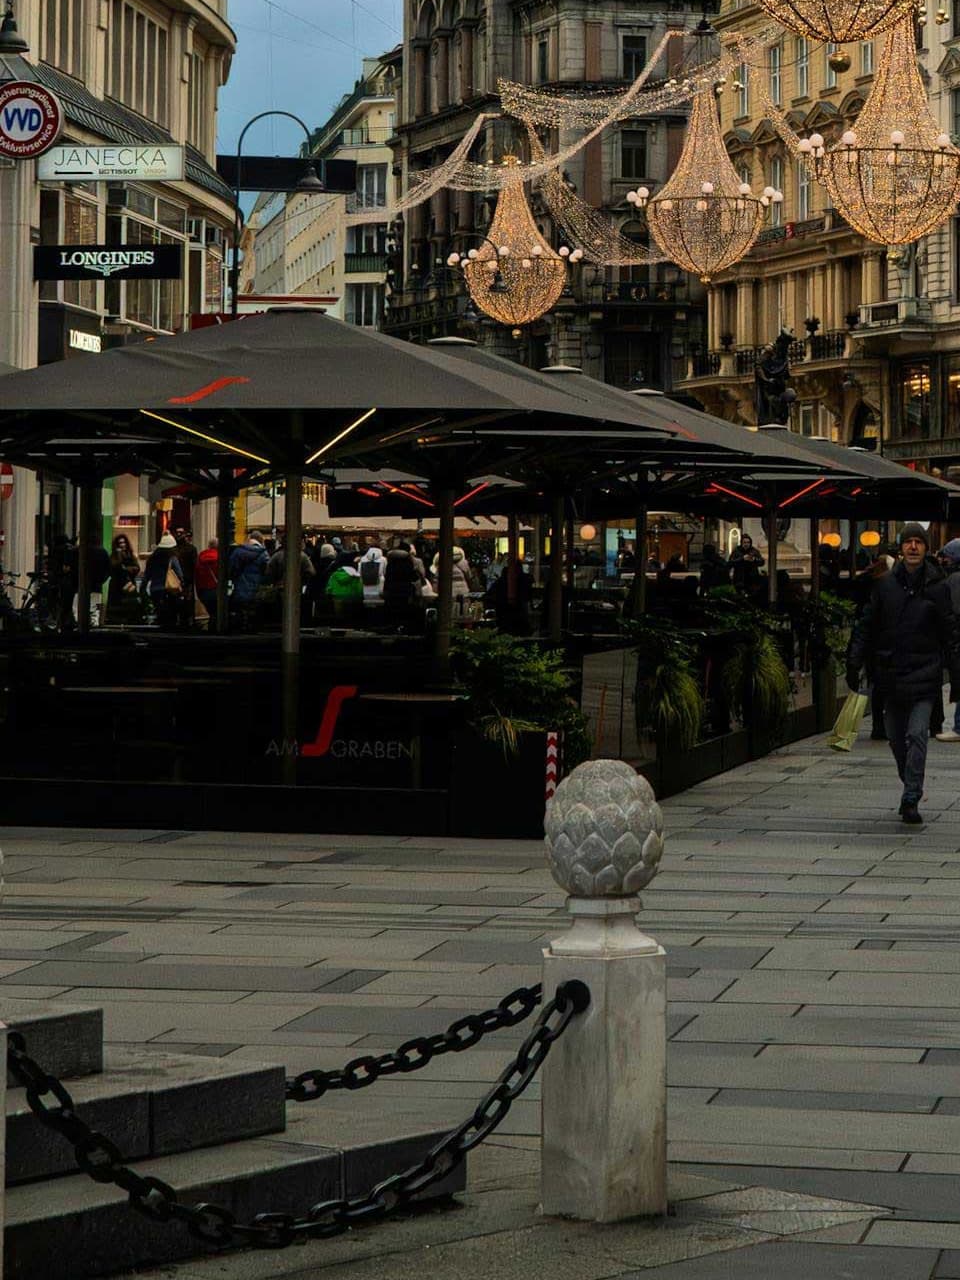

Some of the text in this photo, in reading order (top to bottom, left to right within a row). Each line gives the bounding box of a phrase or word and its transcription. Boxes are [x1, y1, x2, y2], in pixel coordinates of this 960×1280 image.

[54, 149, 167, 166] JANECKA
[60, 251, 154, 265] LONGINES
[264, 739, 415, 759] AM GRABEN
